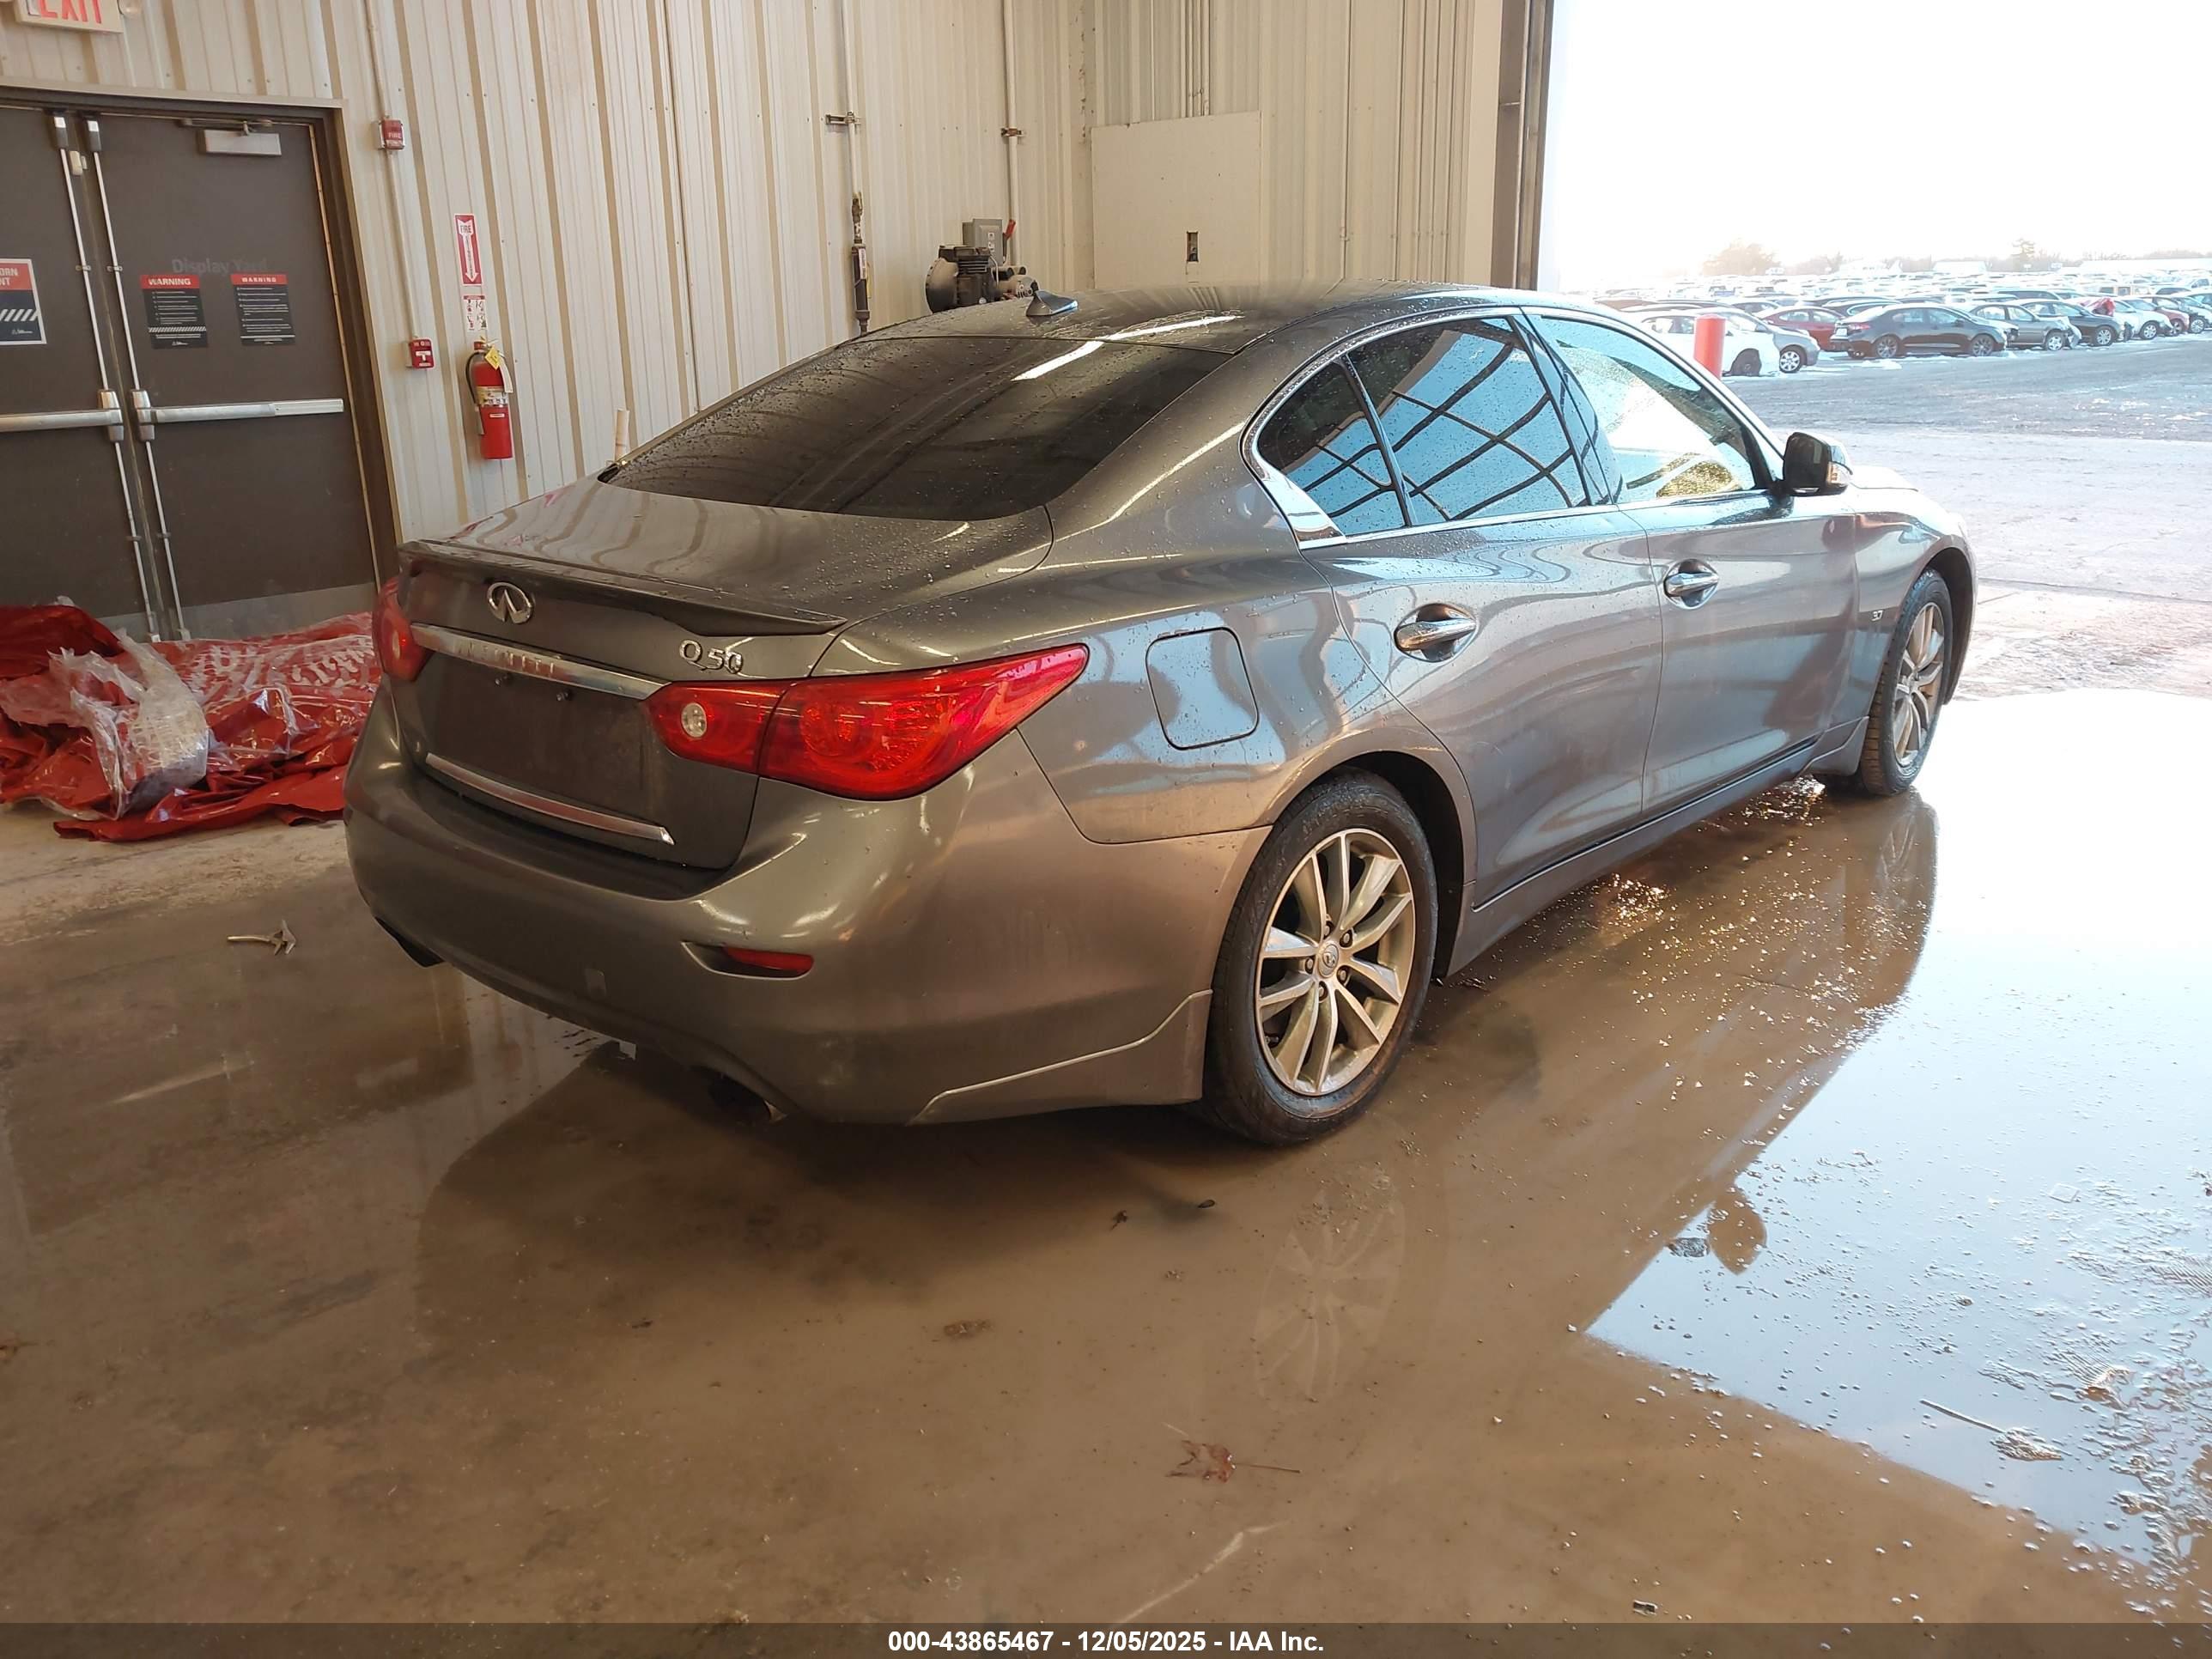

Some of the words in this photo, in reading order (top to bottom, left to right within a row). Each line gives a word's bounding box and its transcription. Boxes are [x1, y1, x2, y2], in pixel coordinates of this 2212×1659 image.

[459, 225, 472, 234] FIRE
[171, 256, 230, 276] Display
[148, 277, 191, 286] WARNING
[678, 639, 744, 674] Q50
